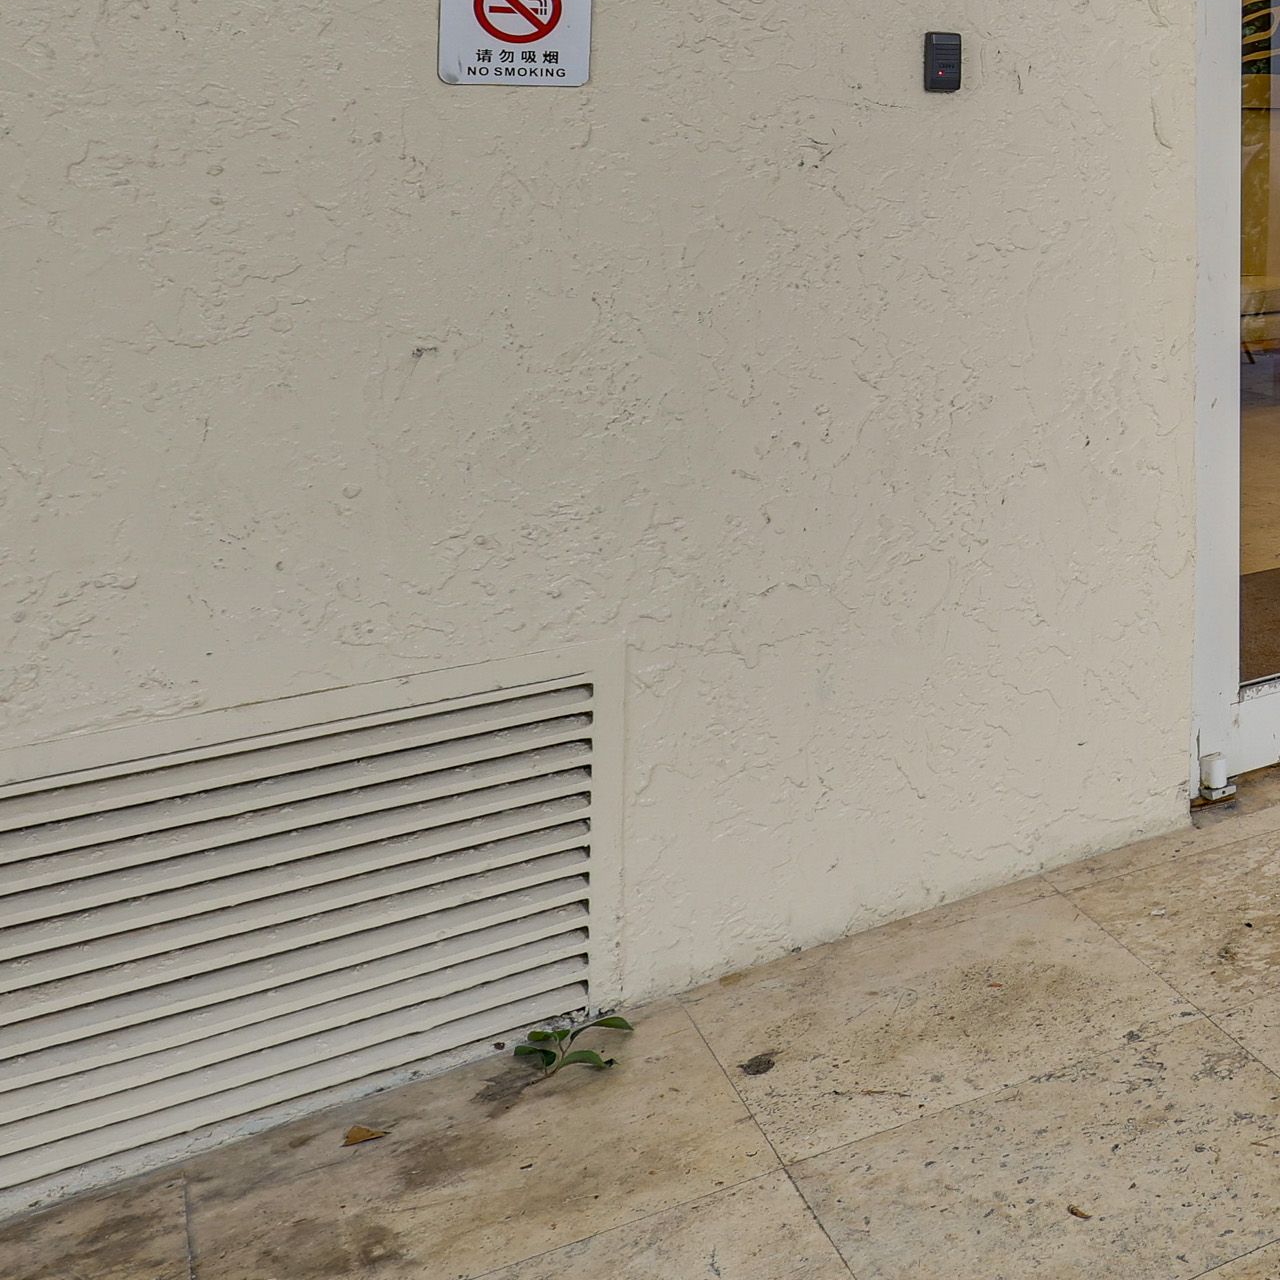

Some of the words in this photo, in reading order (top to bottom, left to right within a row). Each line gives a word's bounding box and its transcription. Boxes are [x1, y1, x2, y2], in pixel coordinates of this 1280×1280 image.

[476, 49, 559, 64] 请勿吸烟
[467, 66, 490, 76] NO
[494, 67, 566, 78] SMOKING
